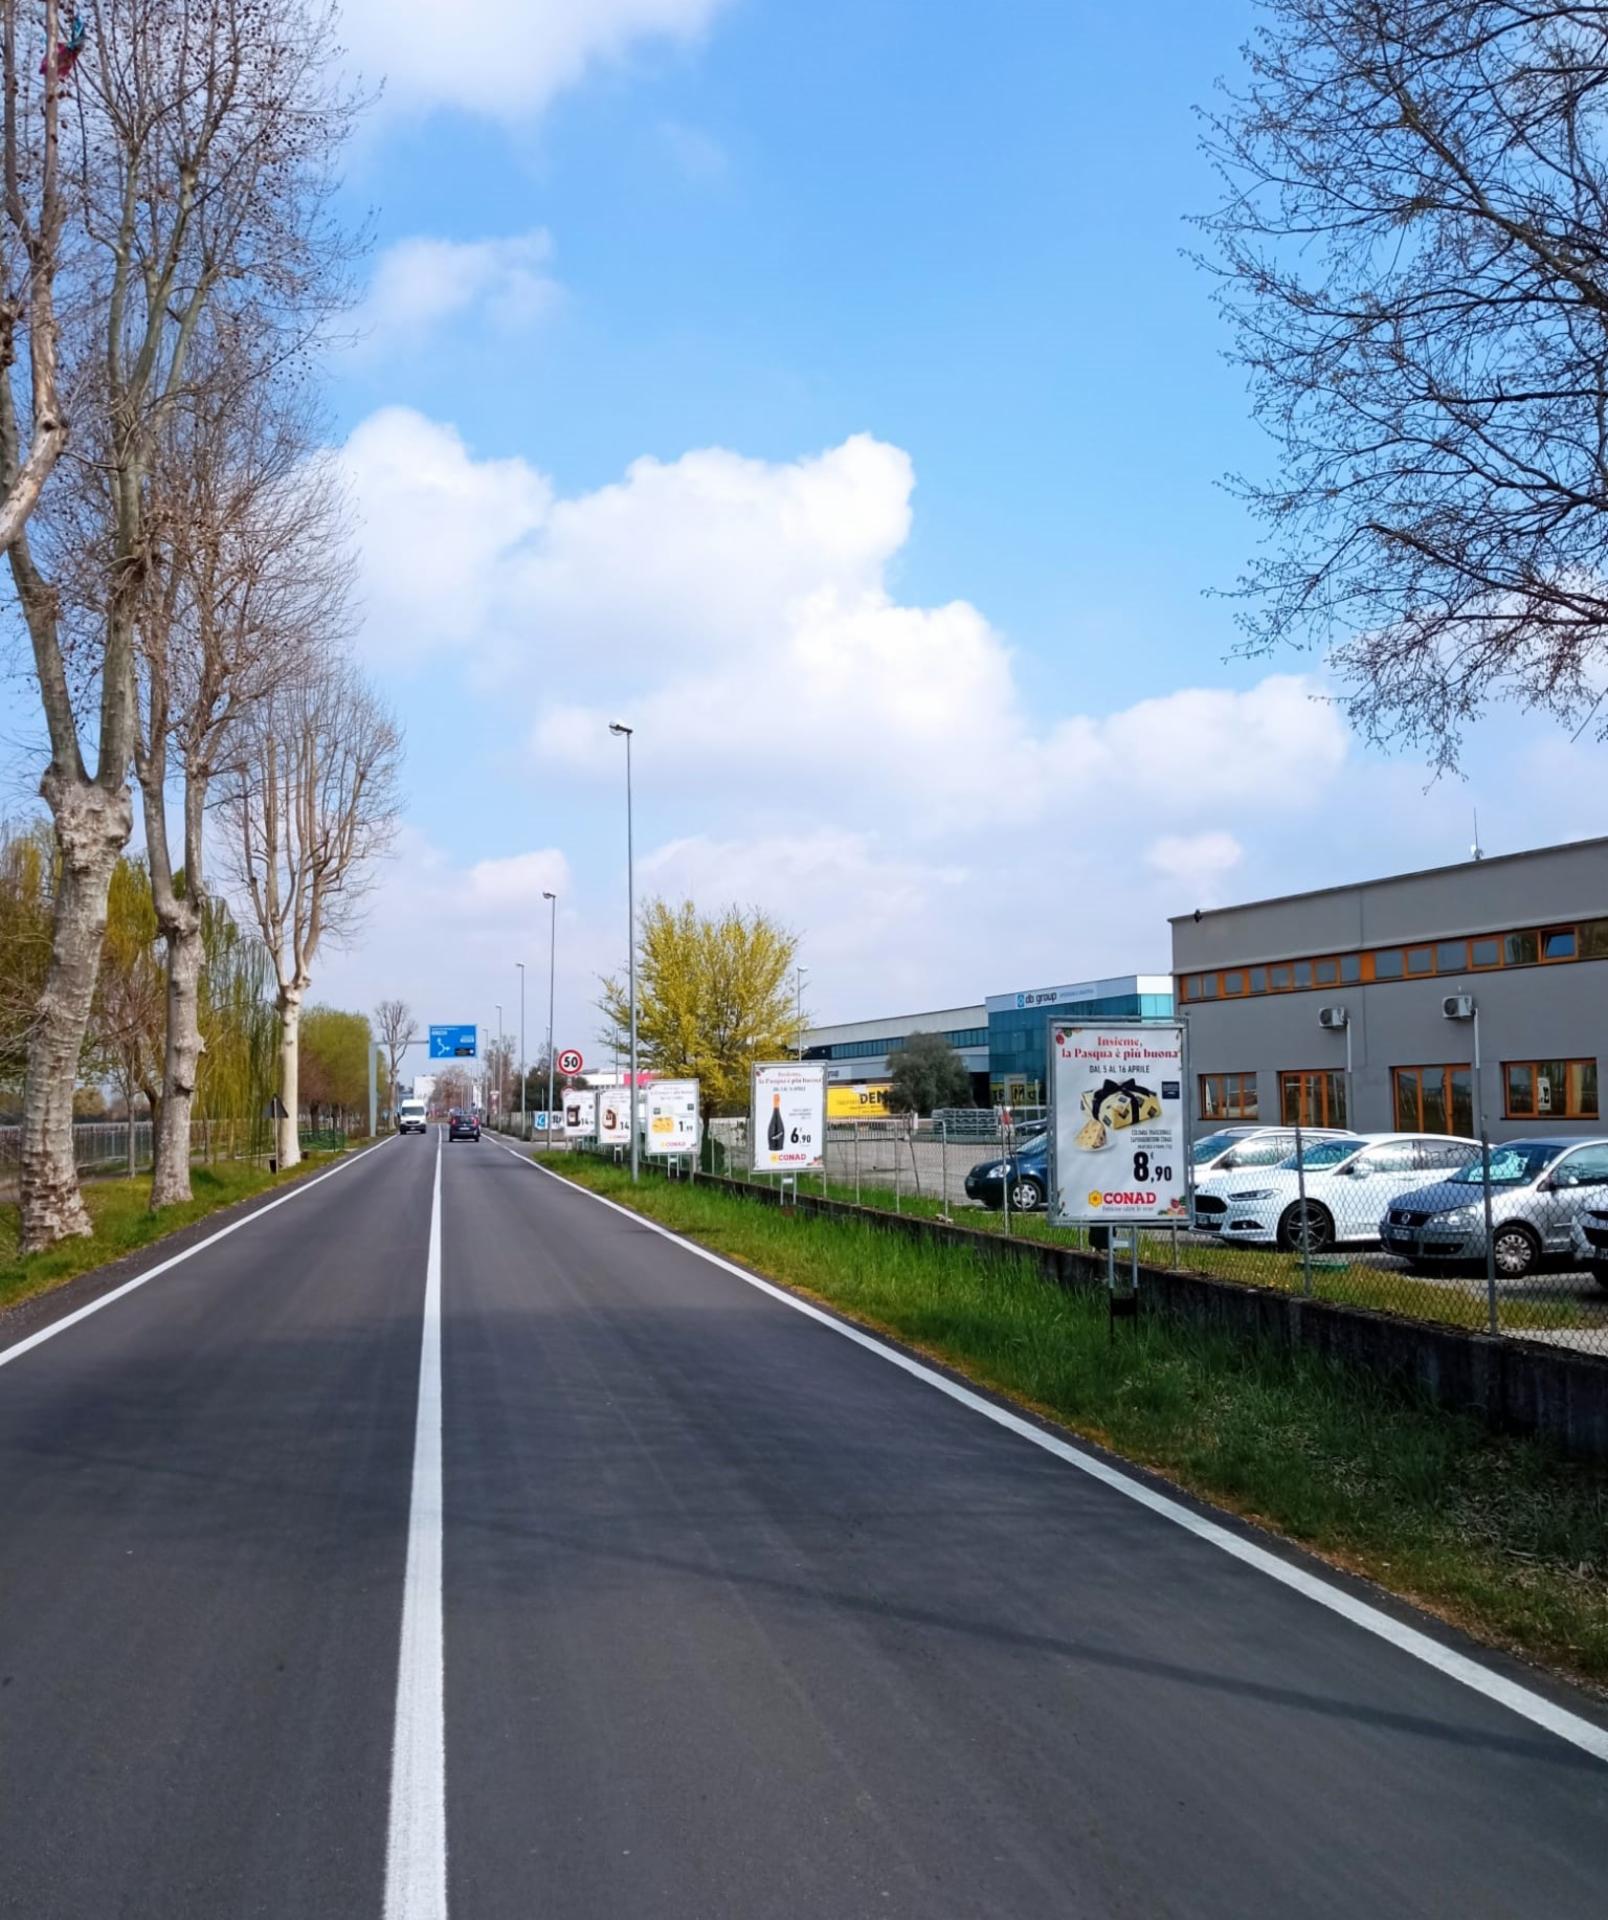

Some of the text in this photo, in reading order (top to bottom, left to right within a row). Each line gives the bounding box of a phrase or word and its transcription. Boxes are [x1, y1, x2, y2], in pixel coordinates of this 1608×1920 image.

[1025, 993, 1034, 1004] db
[1035, 991, 1057, 1005] group
[1097, 1036, 1143, 1047] Insieme,
[1062, 1048, 1071, 1058] la
[1074, 1048, 1113, 1061] Pasqua
[1144, 1048, 1178, 1058] buona
[563, 1056, 578, 1068] 50
[1089, 1065, 1150, 1074] DAL 5 AL 16 APRILE
[790, 1127, 811, 1144] 6,90
[778, 1153, 807, 1161] CONAD
[1133, 1151, 1172, 1183] 8,90
[1103, 1191, 1156, 1205] CONAD
